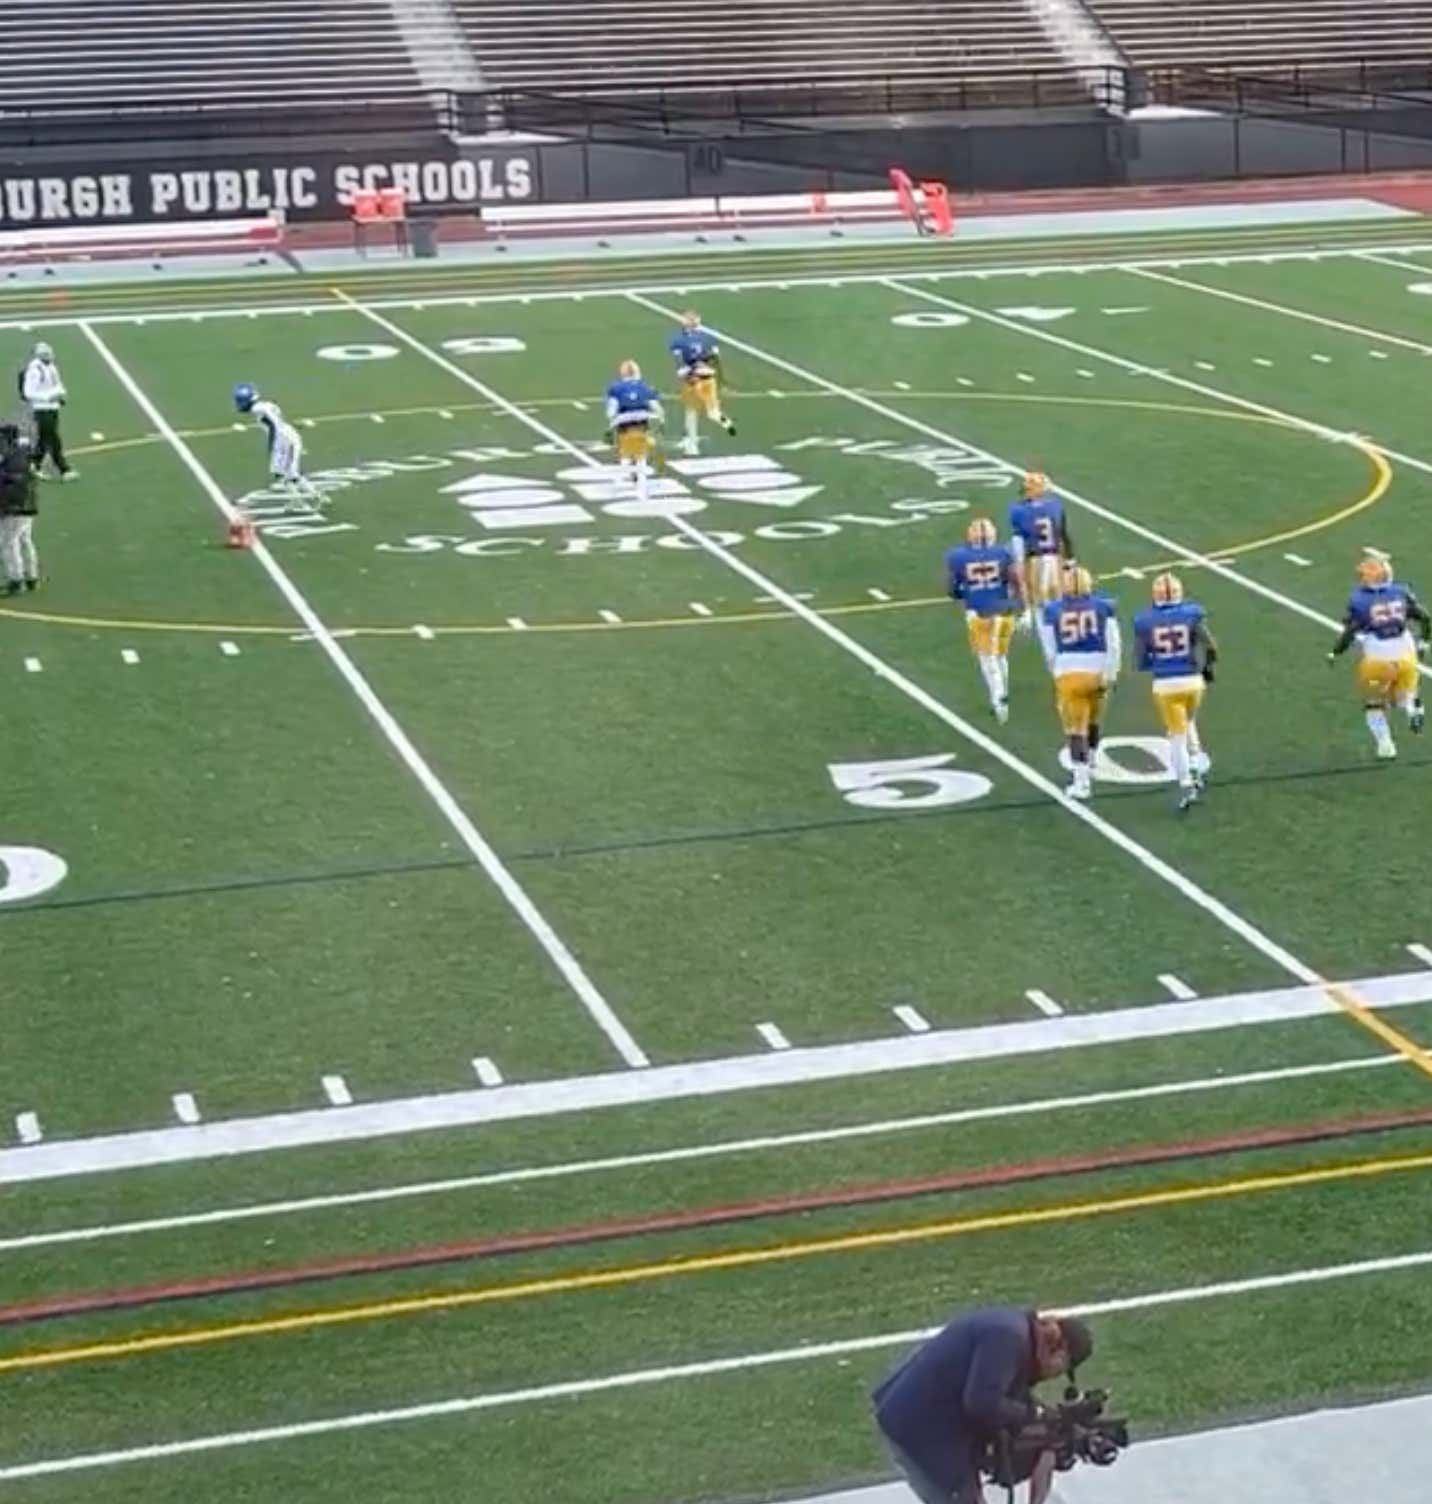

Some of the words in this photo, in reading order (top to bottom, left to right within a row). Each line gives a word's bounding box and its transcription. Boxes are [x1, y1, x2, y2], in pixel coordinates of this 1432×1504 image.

[0, 174, 133, 221] URGH
[151, 166, 317, 214] PUBLIC
[335, 158, 531, 206] SCHOOLS
[374, 498, 971, 556] SCHOOLS
[1034, 517, 1055, 549] 3
[965, 561, 1000, 591] 52
[1059, 610, 1098, 644] 50
[1152, 624, 1190, 658] 53
